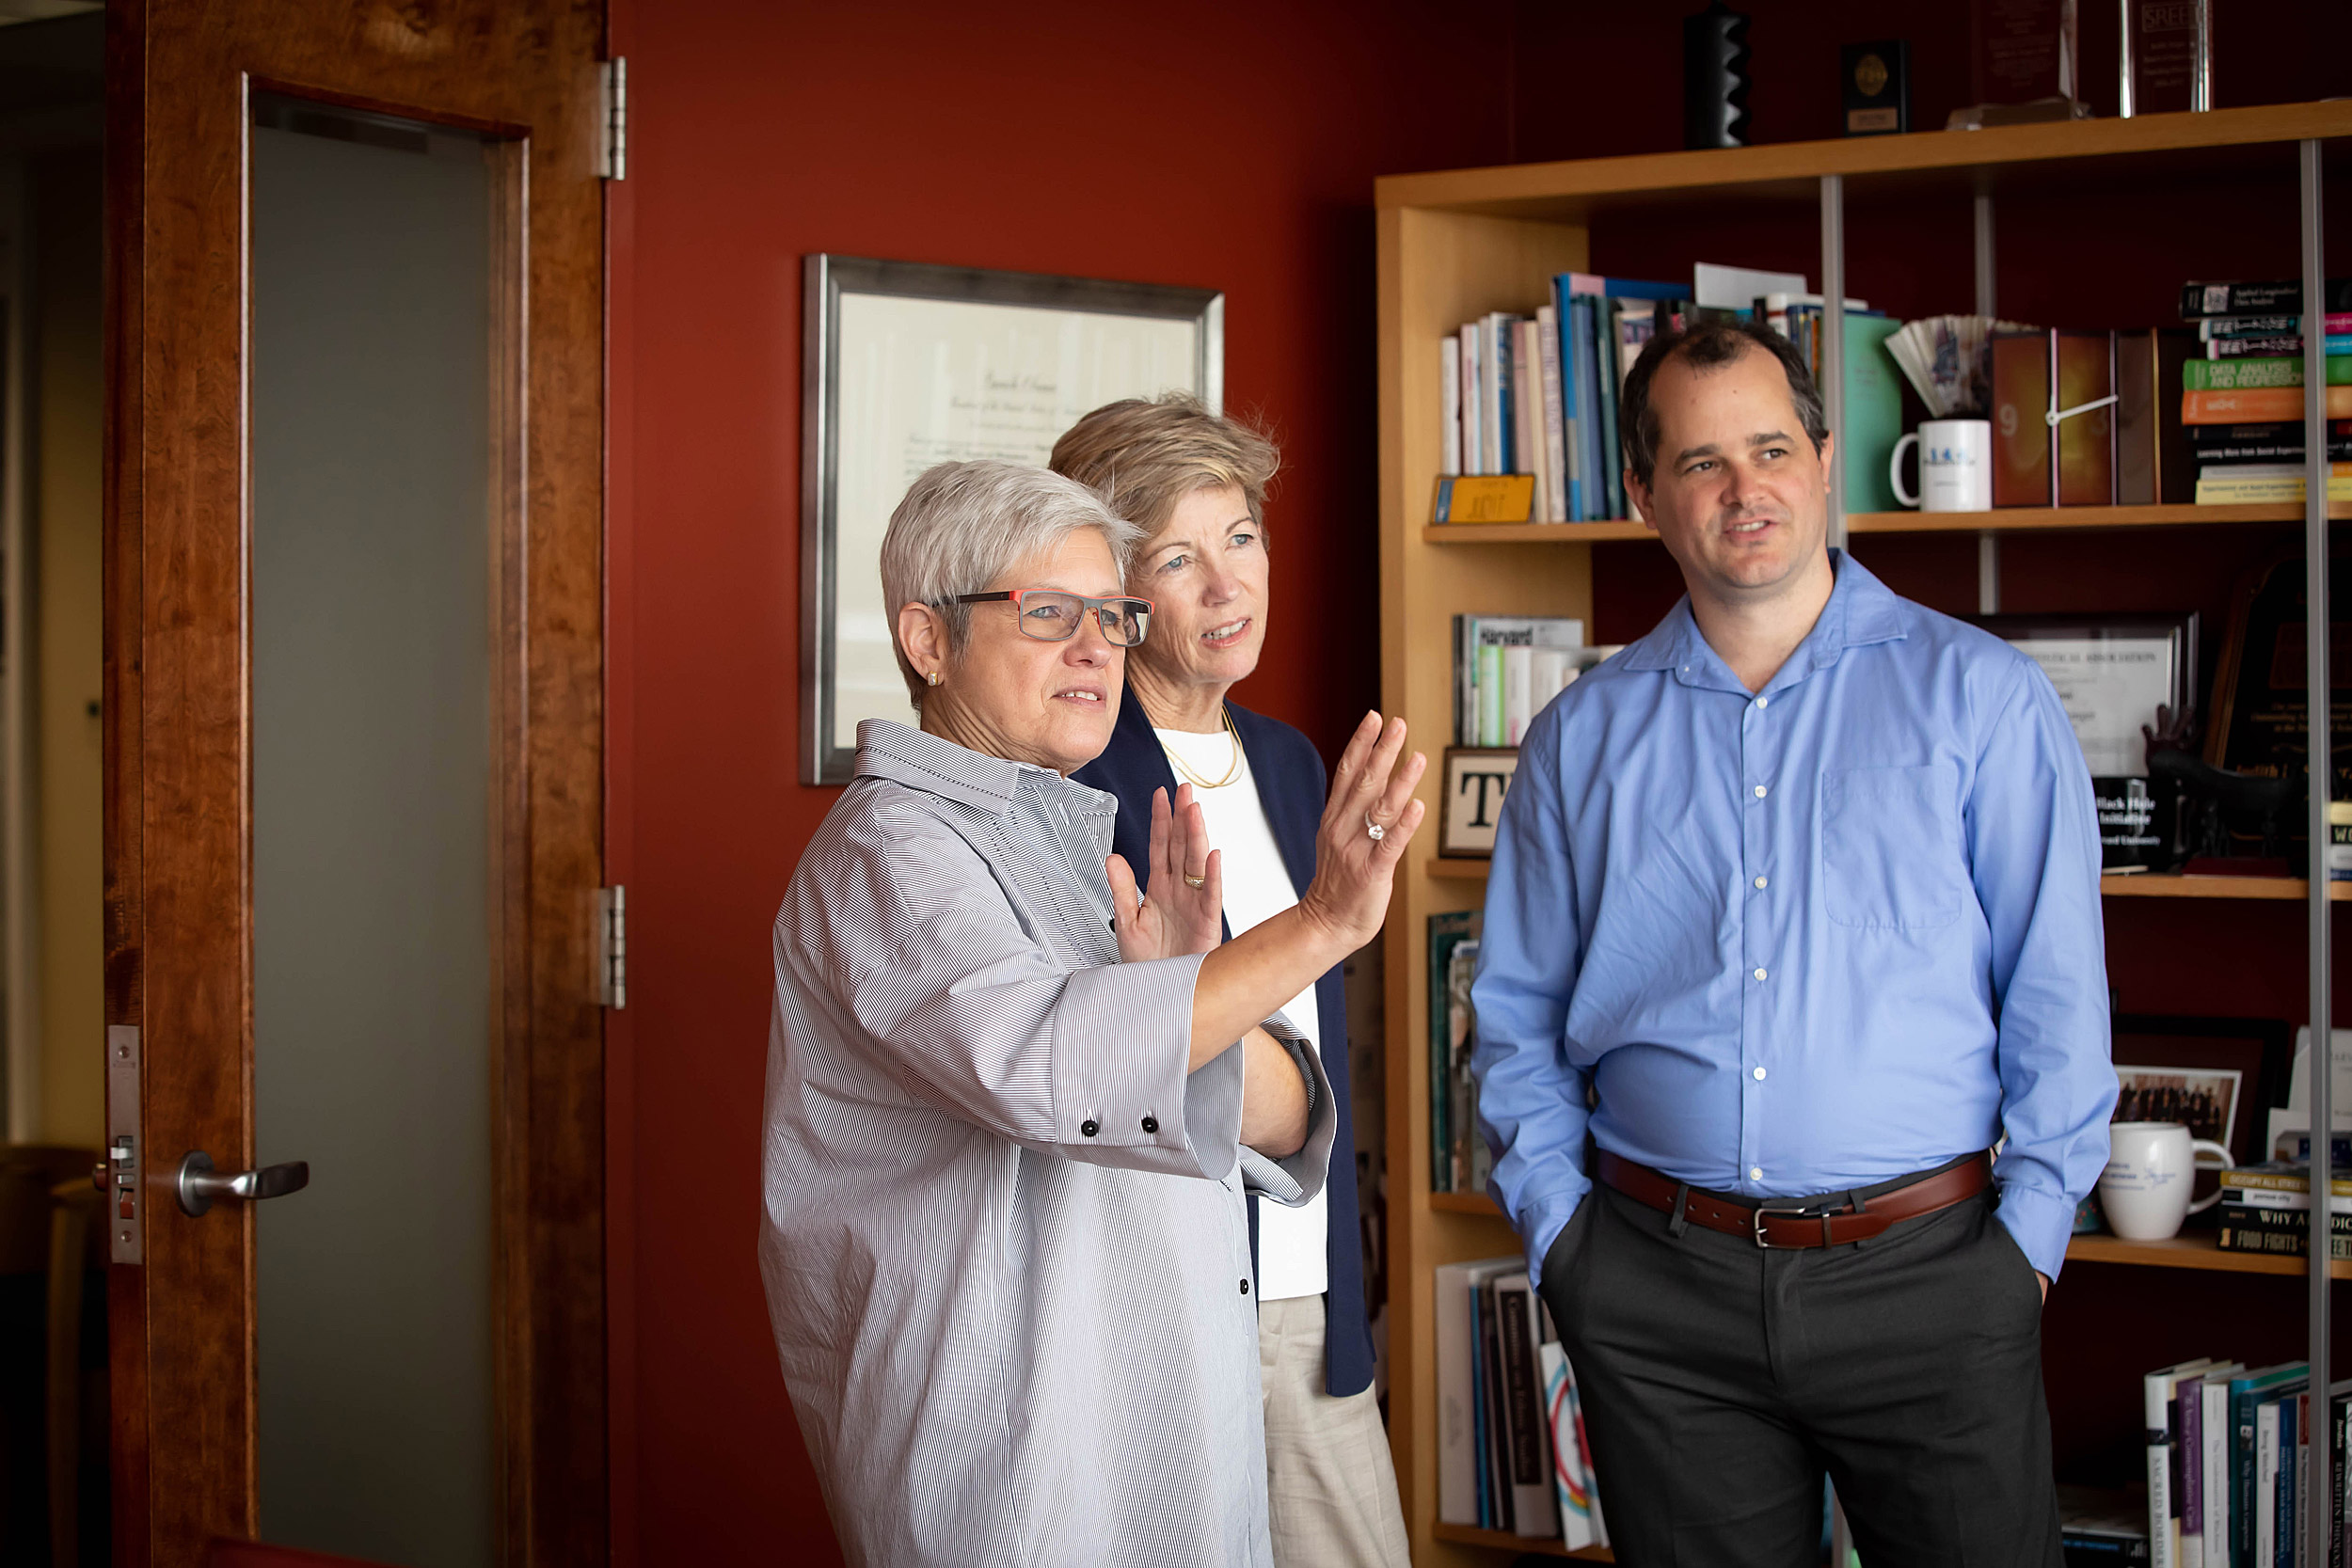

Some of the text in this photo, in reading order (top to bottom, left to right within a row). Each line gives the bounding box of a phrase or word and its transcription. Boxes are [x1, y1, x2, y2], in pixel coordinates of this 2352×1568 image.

[2209, 363, 2237, 378] DATA
[2238, 360, 2293, 377] ANALYSIS
[2210, 375, 2235, 388] AND
[1998, 404, 2018, 437] 9
[2197, 449, 2223, 459] Learning
[2256, 445, 2276, 456] Social
[2121, 835, 2161, 847] University
[2263, 1177, 2277, 1188] ALL
[2259, 1210, 2292, 1226] WHY
[2236, 1229, 2262, 1249] FOOD
[2264, 1231, 2298, 1253] FIGHTS
[2261, 1430, 2270, 1449] Being
[2184, 1436, 2197, 1505] Contemplative
[2243, 1460, 2251, 1478] Why
[2334, 1462, 2344, 1516] REWRITTEN
[2185, 1506, 2197, 1529] Care
[2242, 1513, 2251, 1551] Cooperate
